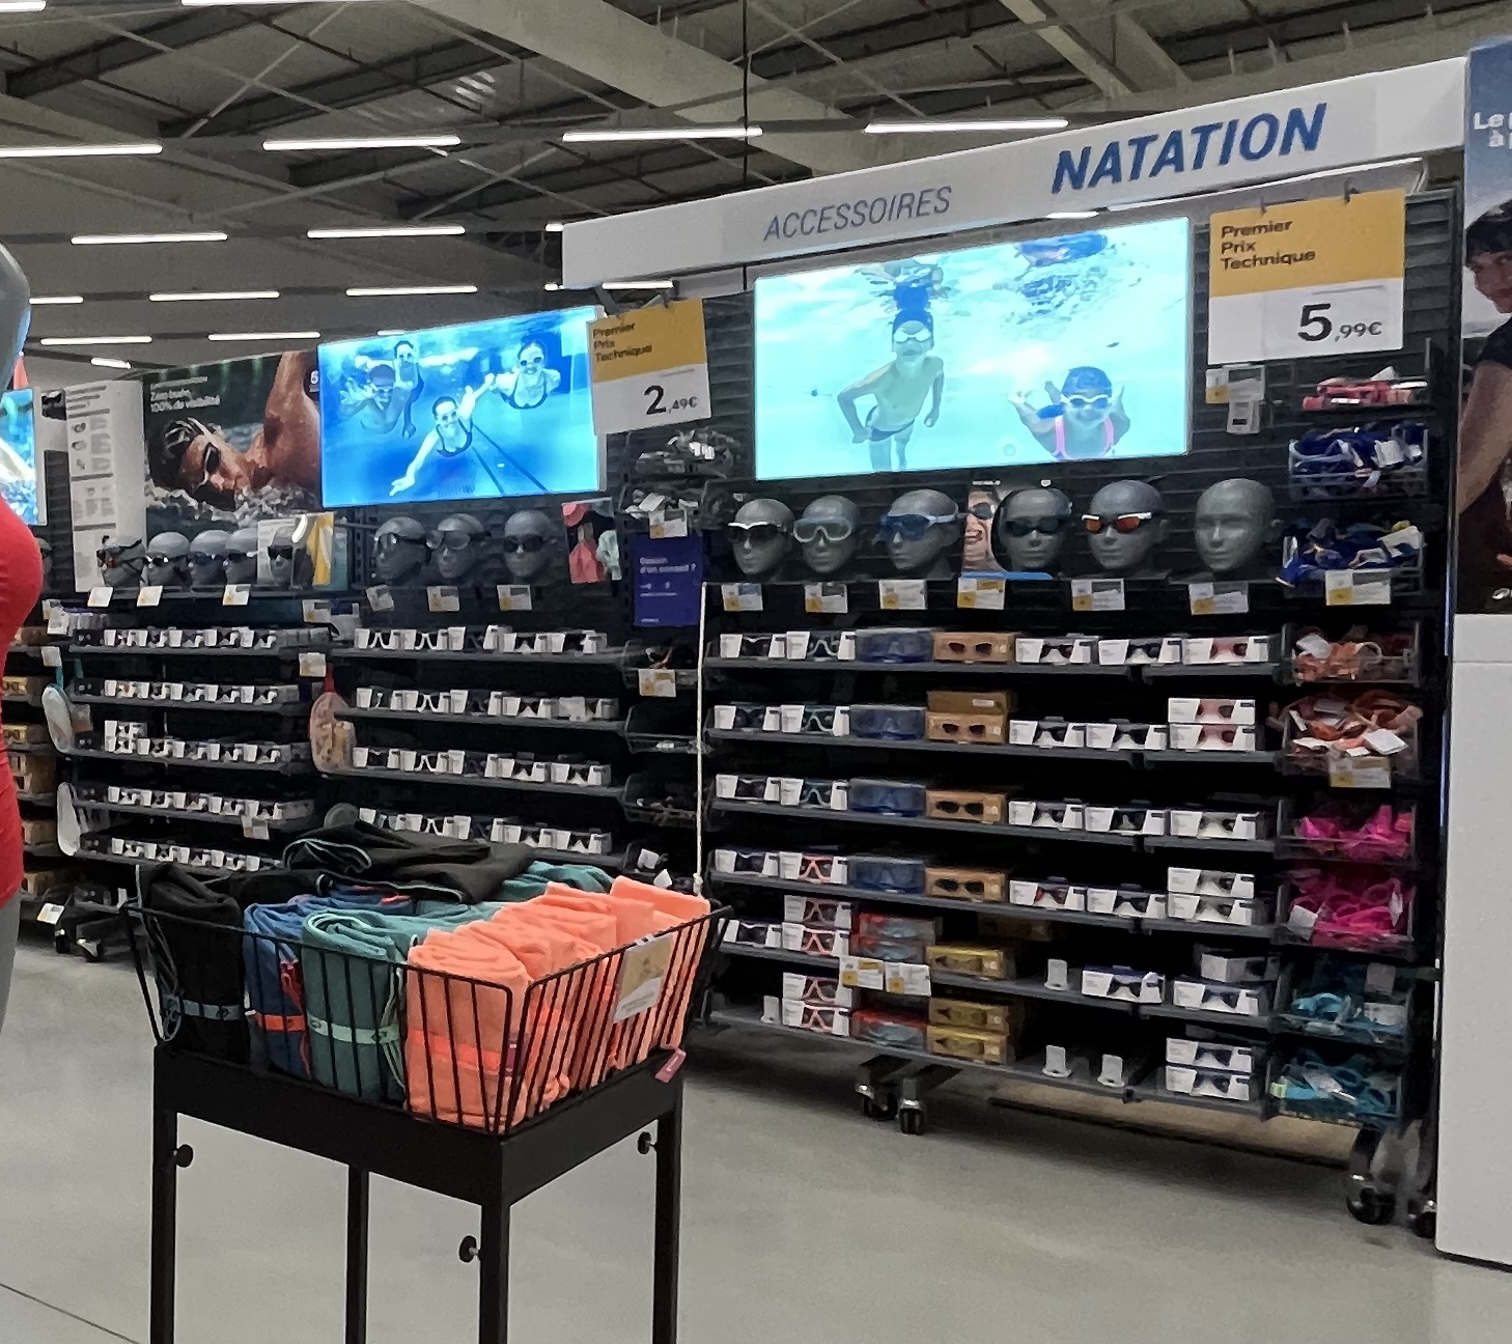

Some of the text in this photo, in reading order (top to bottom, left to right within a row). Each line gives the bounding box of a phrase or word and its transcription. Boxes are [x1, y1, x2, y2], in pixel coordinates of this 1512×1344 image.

[1473, 112, 1505, 130] Le
[1050, 102, 1328, 195] NATATION
[762, 186, 954, 243] ACCESSOIRES
[1221, 220, 1294, 239] Premier
[1221, 241, 1257, 255] Prix
[1220, 250, 1316, 271] Technique
[1297, 303, 1384, 342] 5,99€
